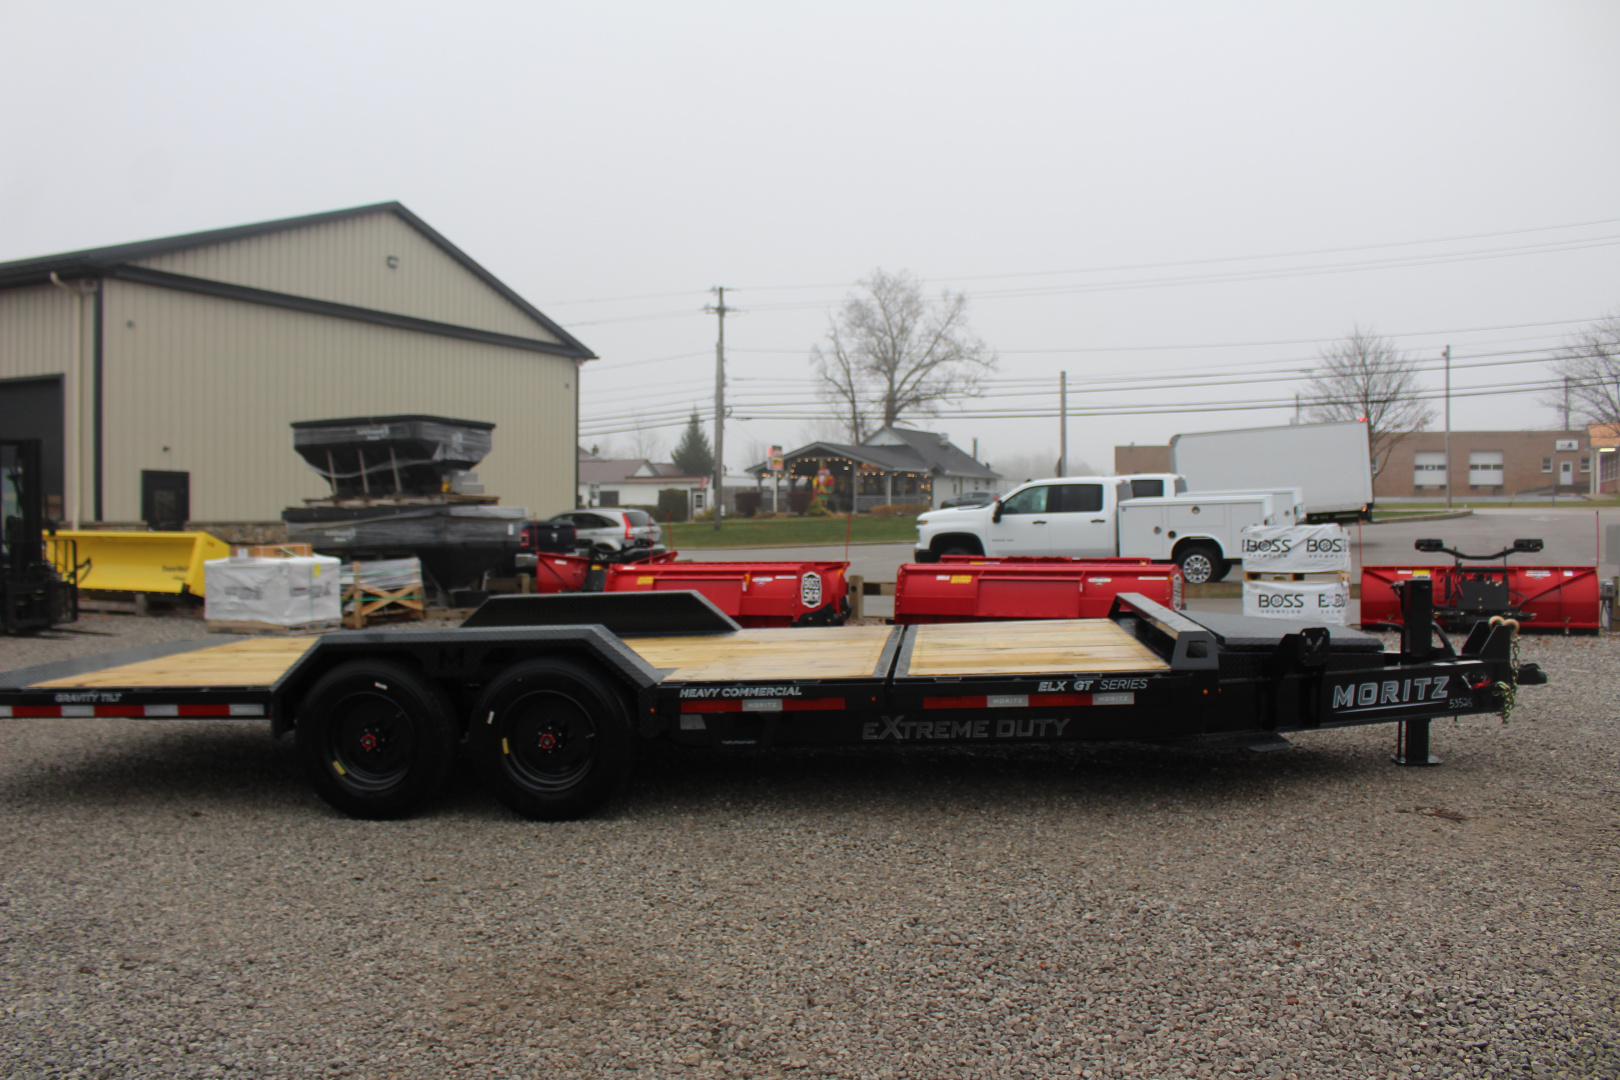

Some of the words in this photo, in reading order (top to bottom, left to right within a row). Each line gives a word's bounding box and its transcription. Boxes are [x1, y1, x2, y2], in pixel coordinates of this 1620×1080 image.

[1247, 539, 1291, 553] BOSS
[1258, 594, 1304, 608] BOSS
[679, 688, 720, 698] HEAVY
[721, 686, 802, 697] COMMERCIAL
[1038, 681, 1067, 692] ELX
[1073, 680, 1094, 691] GT
[1099, 678, 1148, 690] SERIES
[1332, 676, 1450, 708] MORITZ
[55, 692, 98, 702] GRAVITY
[101, 693, 122, 702] TILT
[996, 718, 1071, 738] DUTY
